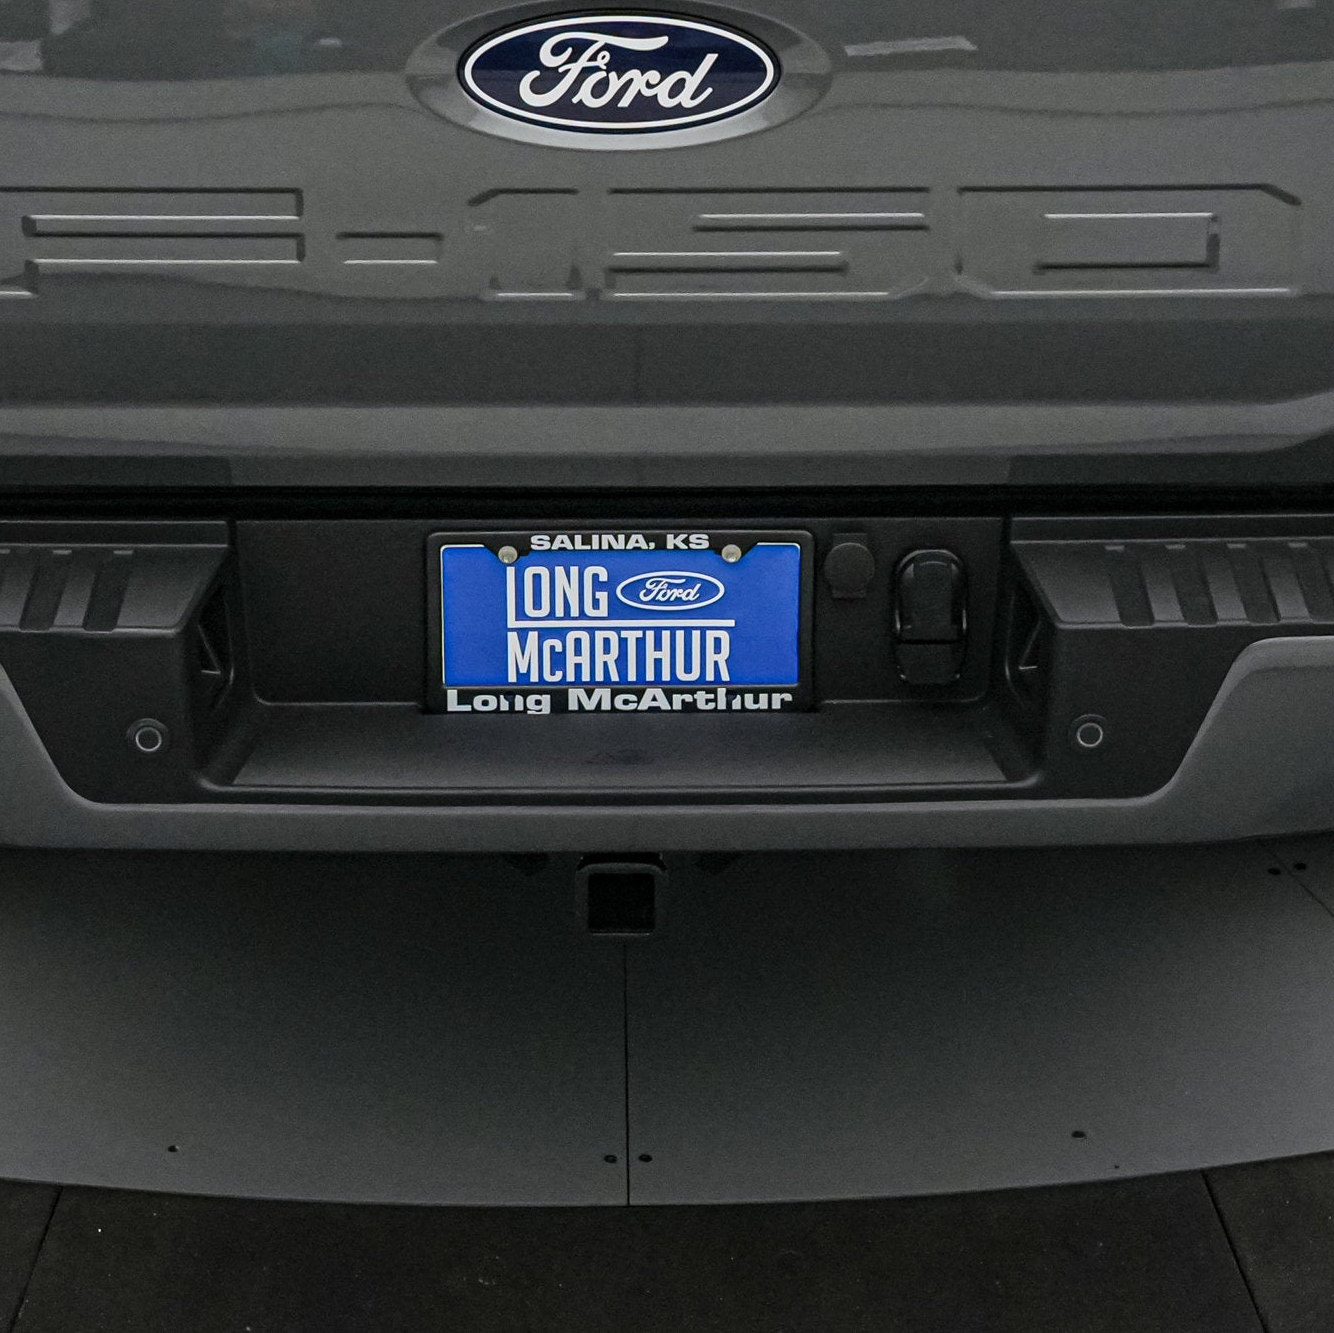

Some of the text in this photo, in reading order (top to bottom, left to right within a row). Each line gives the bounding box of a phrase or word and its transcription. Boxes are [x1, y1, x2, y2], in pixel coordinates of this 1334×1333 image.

[518, 31, 718, 108] Ford
[530, 533, 710, 551] SALINA, KS
[506, 565, 700, 621] LONG Ford
[507, 629, 731, 683] McARTHUR
[446, 688, 552, 715] Long
